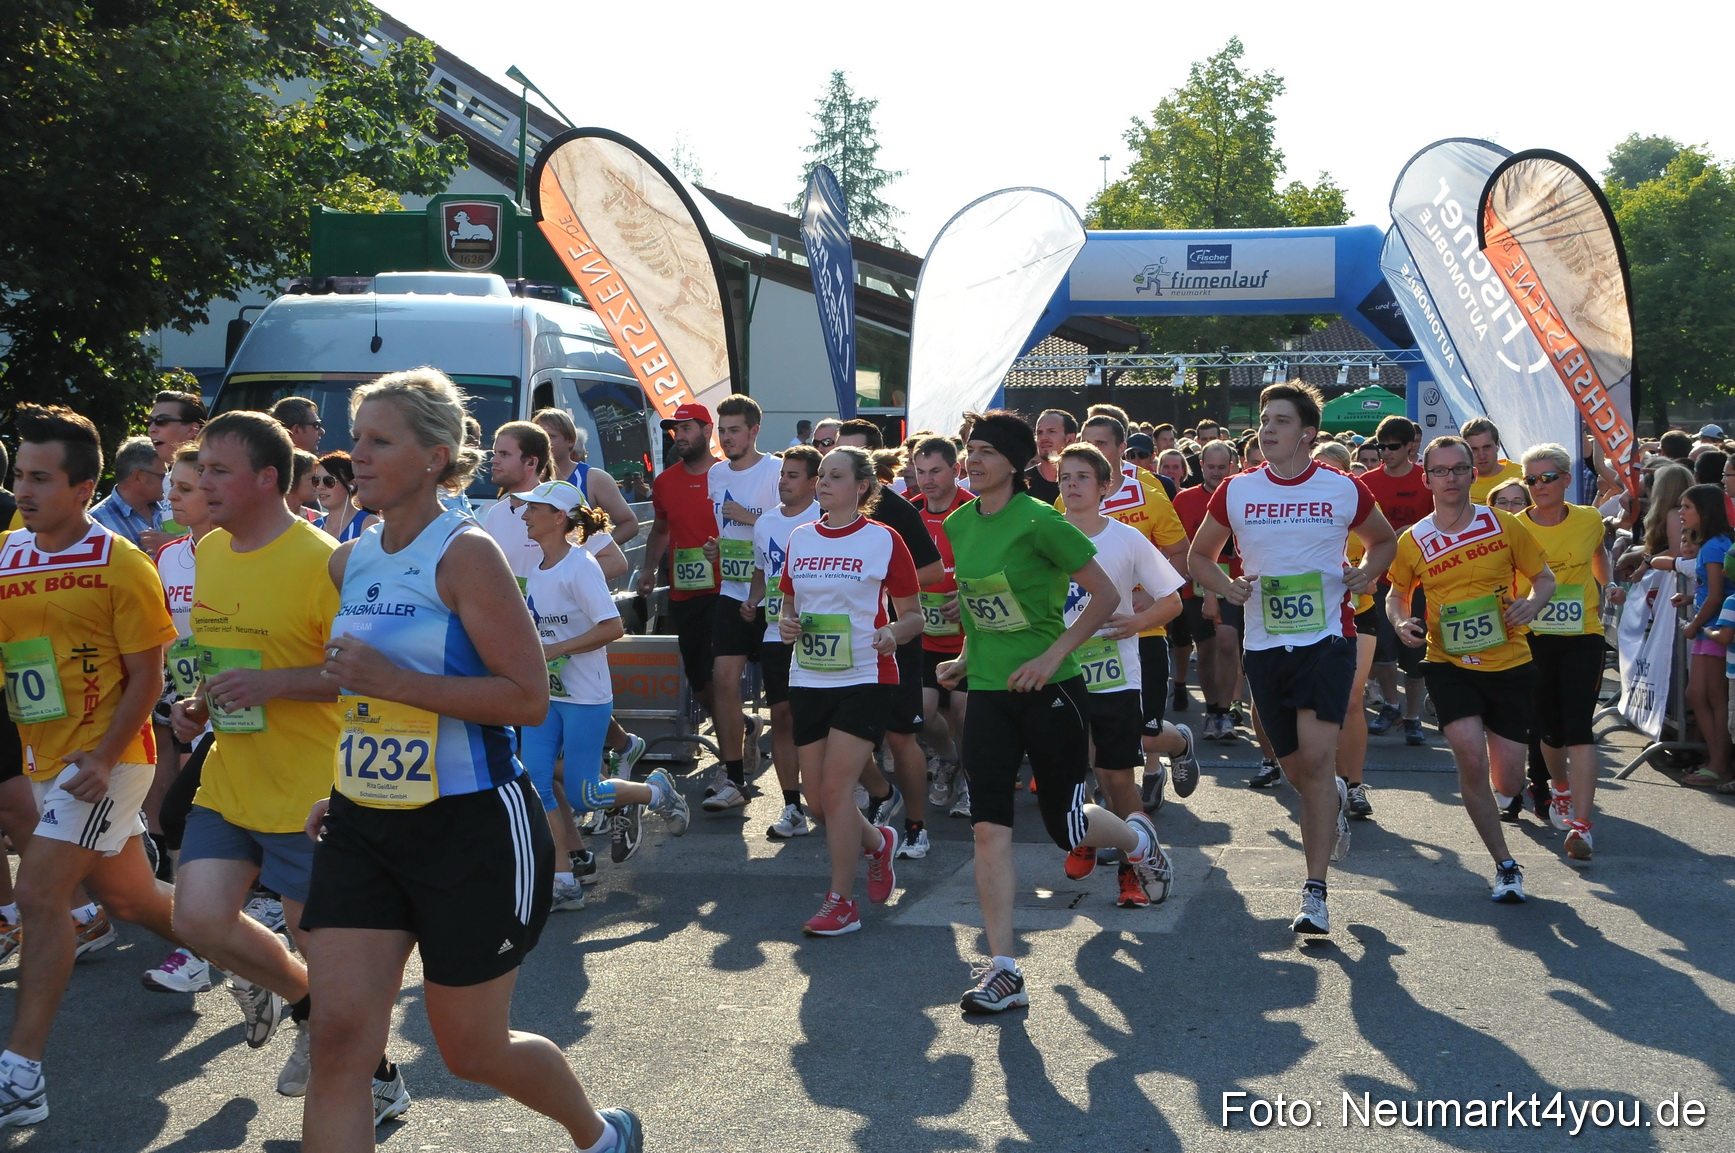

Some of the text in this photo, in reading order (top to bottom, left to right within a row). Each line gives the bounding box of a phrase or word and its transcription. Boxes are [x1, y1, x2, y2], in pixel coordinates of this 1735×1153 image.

[460, 254, 484, 265] 1628
[1196, 250, 1229, 261] Fischer
[1171, 270, 1270, 289] firmenlauf
[1115, 510, 1149, 525] ÖGL
[1244, 502, 1333, 519] PFEIFFER
[1245, 518, 1281, 526] Immobilien
[1290, 517, 1333, 526] Versicherung
[793, 556, 863, 573] PFEIFFER
[1427, 539, 1508, 578] MAX BÖGL
[676, 562, 706, 580] 952
[824, 572, 861, 582] Versicherung
[45, 571, 109, 592] BÖGL
[966, 595, 1010, 620] 561
[1269, 594, 1314, 620] 956
[1541, 602, 1582, 621] 289
[195, 617, 229, 625] Seniorenstift
[352, 622, 372, 631] TEAM
[1446, 615, 1493, 642] 755
[235, 626, 269, 636] Neumarkt
[801, 633, 841, 657] 957
[1081, 659, 1121, 685] 076
[5, 669, 45, 701] 70
[340, 735, 431, 781] 1232
[359, 791, 408, 799] Schabmüller GmbH
